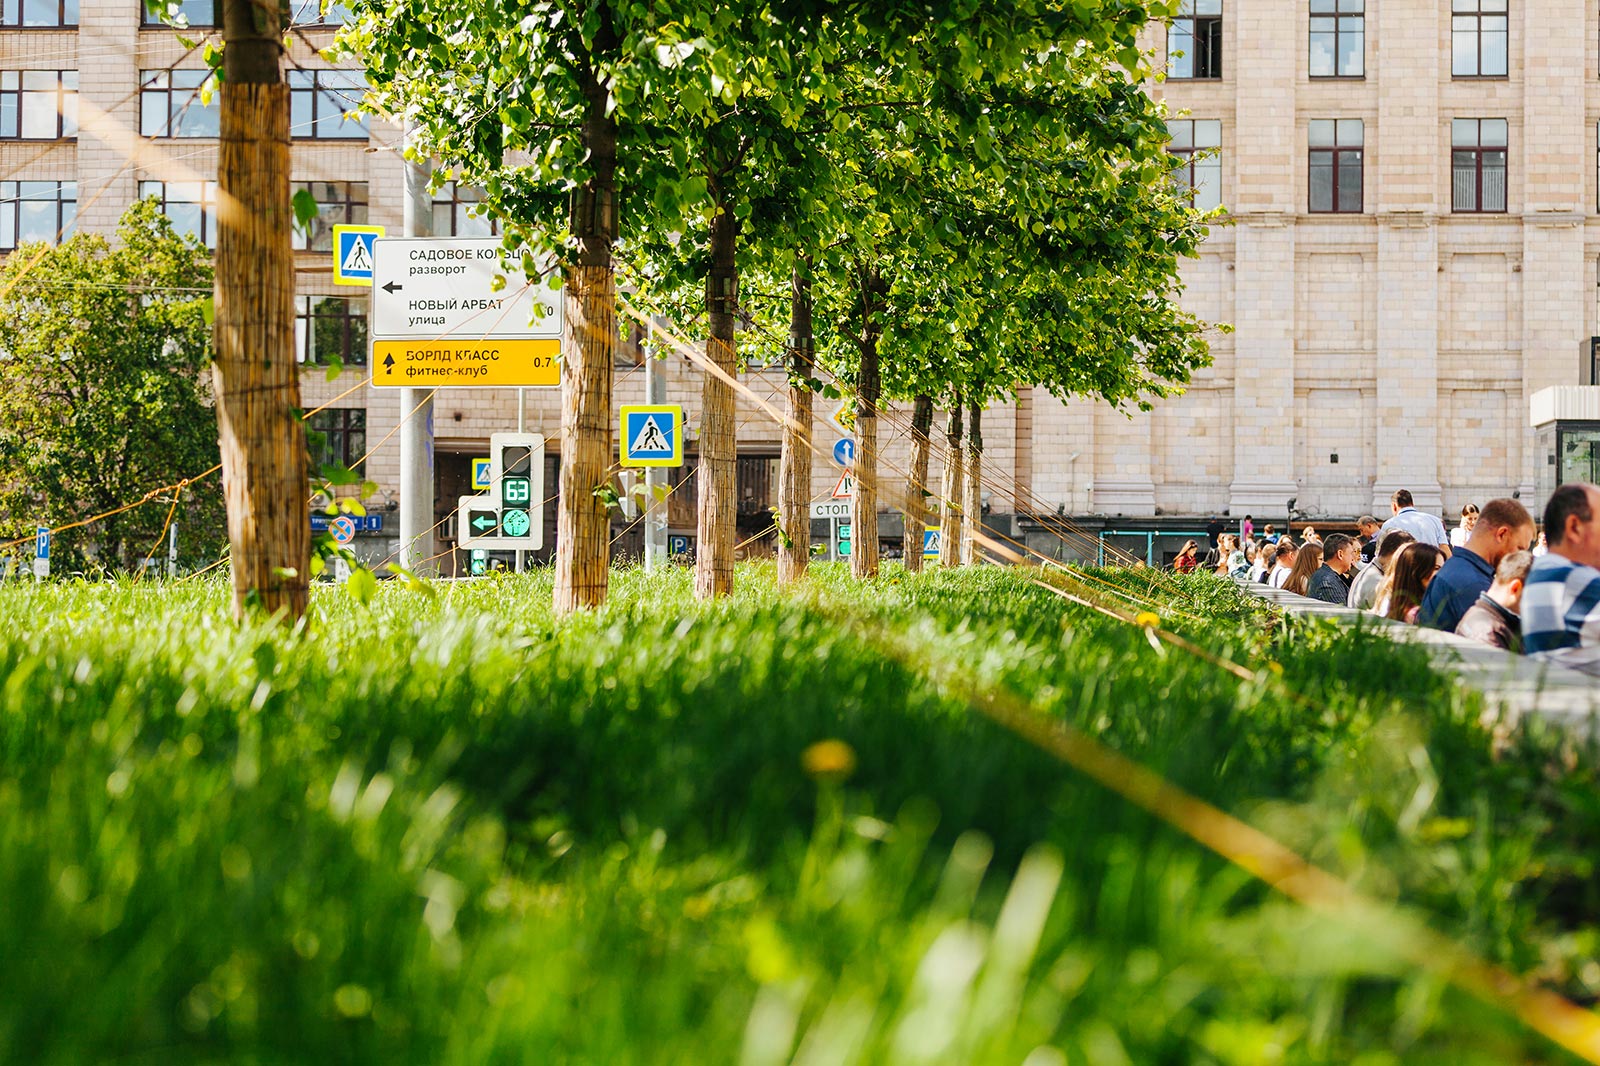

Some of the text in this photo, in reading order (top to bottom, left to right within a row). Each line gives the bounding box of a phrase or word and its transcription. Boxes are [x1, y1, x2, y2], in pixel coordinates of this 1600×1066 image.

[409, 249, 473, 262] САДОВОЕ
[409, 265, 467, 277] разворот
[409, 298, 504, 311] НОВЫЙ АРБАТ
[409, 316, 446, 327] улица
[455, 350, 500, 361] КЛАСС
[533, 357, 552, 368] 0.7
[405, 364, 488, 378] фитнес-клуб
[506, 480, 529, 501] 63
